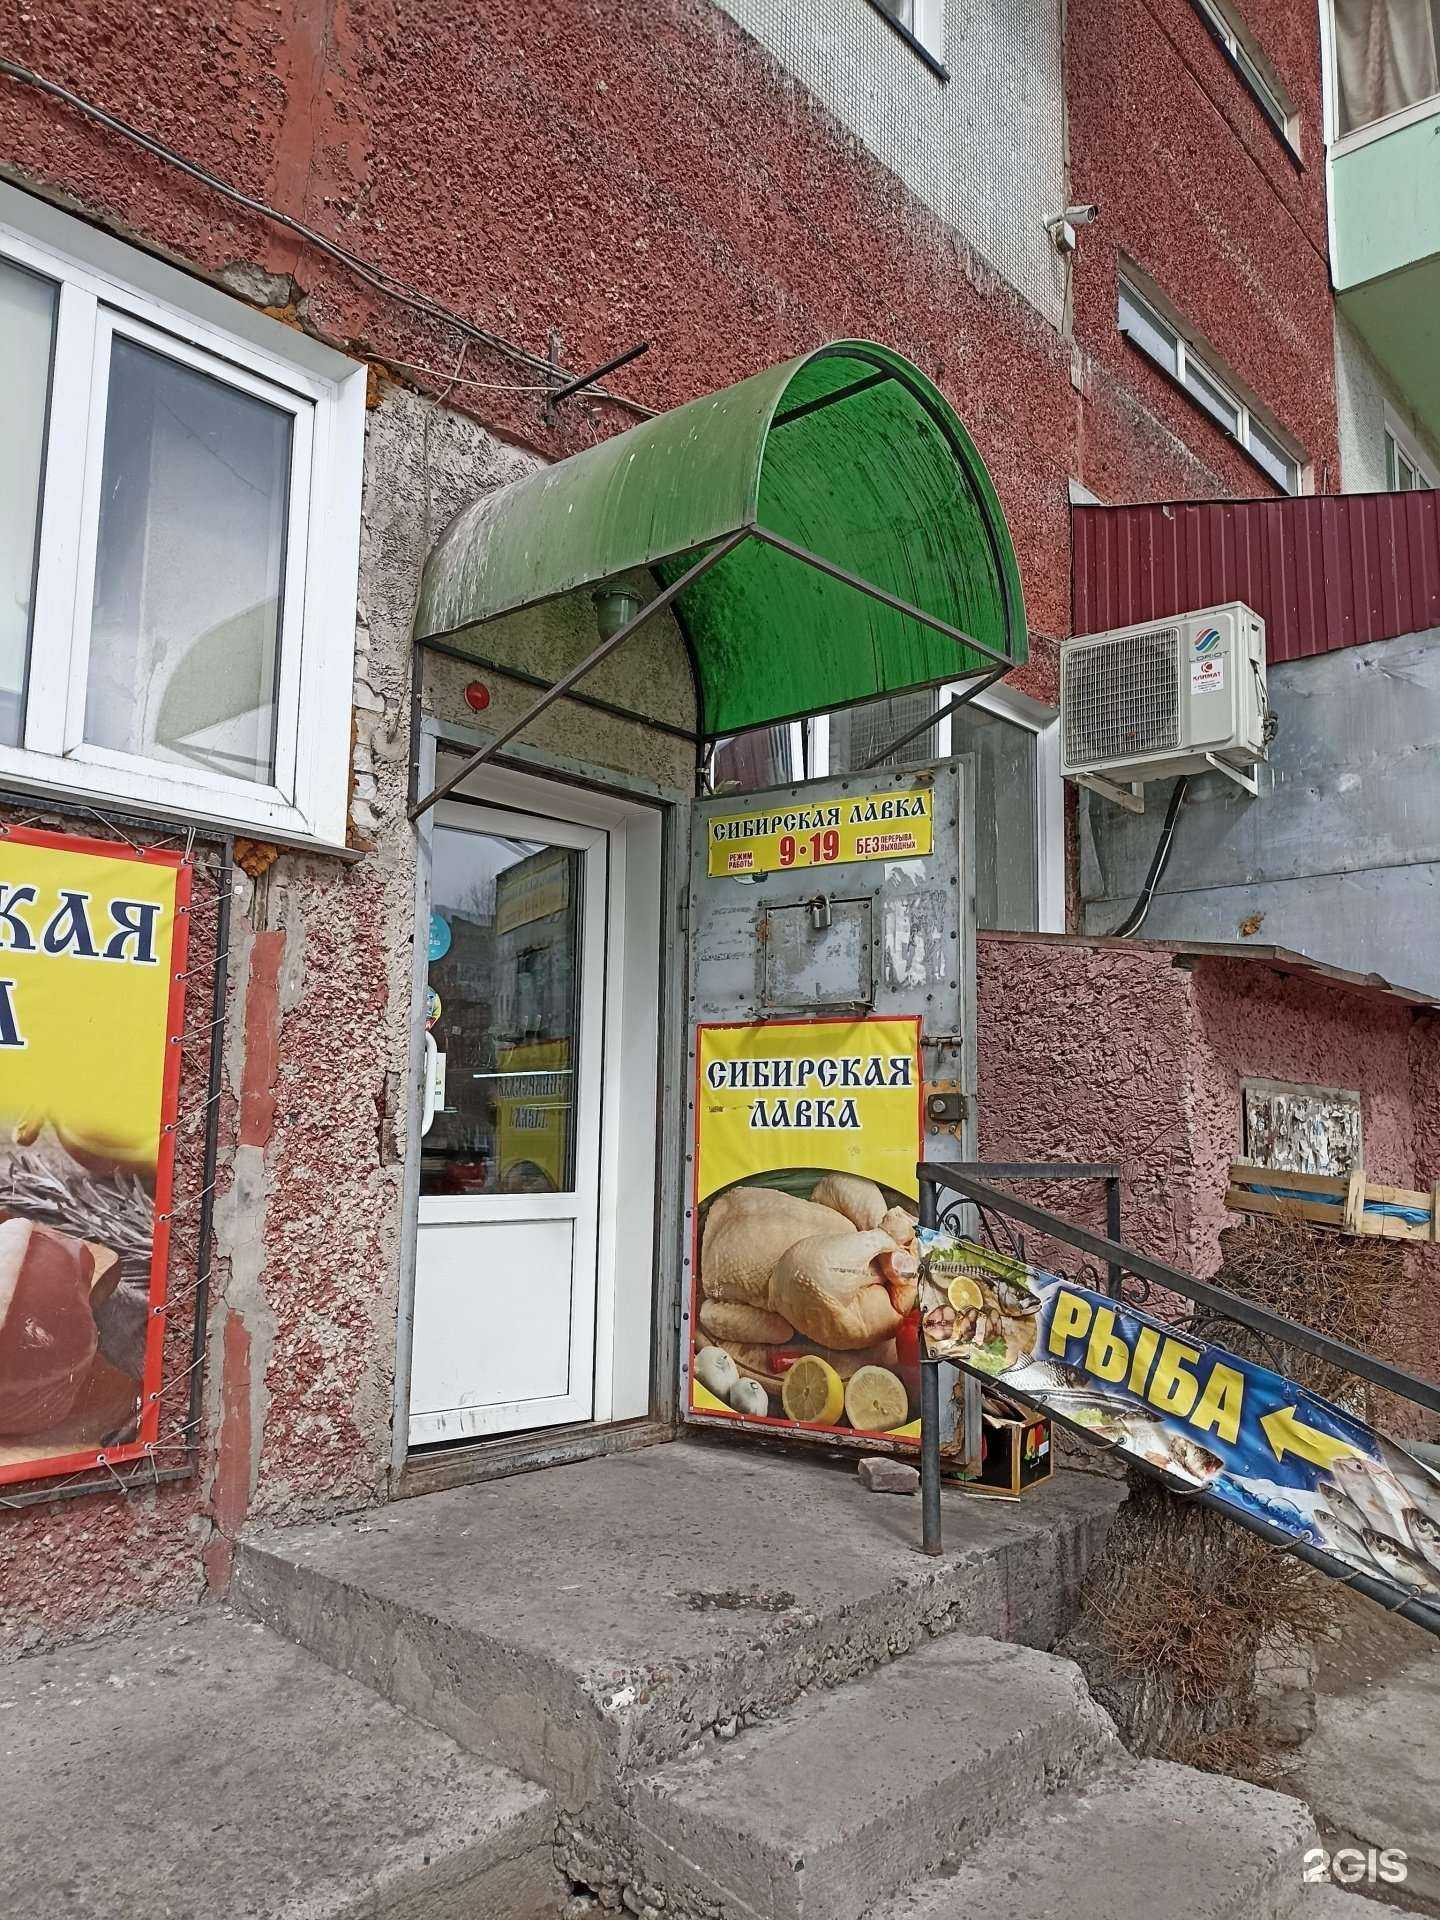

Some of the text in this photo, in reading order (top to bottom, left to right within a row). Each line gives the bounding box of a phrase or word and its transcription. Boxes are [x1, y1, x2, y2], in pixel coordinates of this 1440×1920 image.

[713, 797, 926, 841] СИБИРСКАЯ ЛАВКА
[856, 837, 880, 855] БЕЗ
[880, 833, 912, 844] ПЕРЕРЫВА
[880, 841, 916, 851] ВЫХОДНЫХ
[728, 860, 753, 869] РАБОТЫ
[729, 852, 752, 862] РЕЖИМ
[707, 1057, 912, 1089] СИБИРСКАЯ
[751, 1099, 861, 1128] ЛАВКА
[1048, 1289, 1245, 1445] РЫБА
